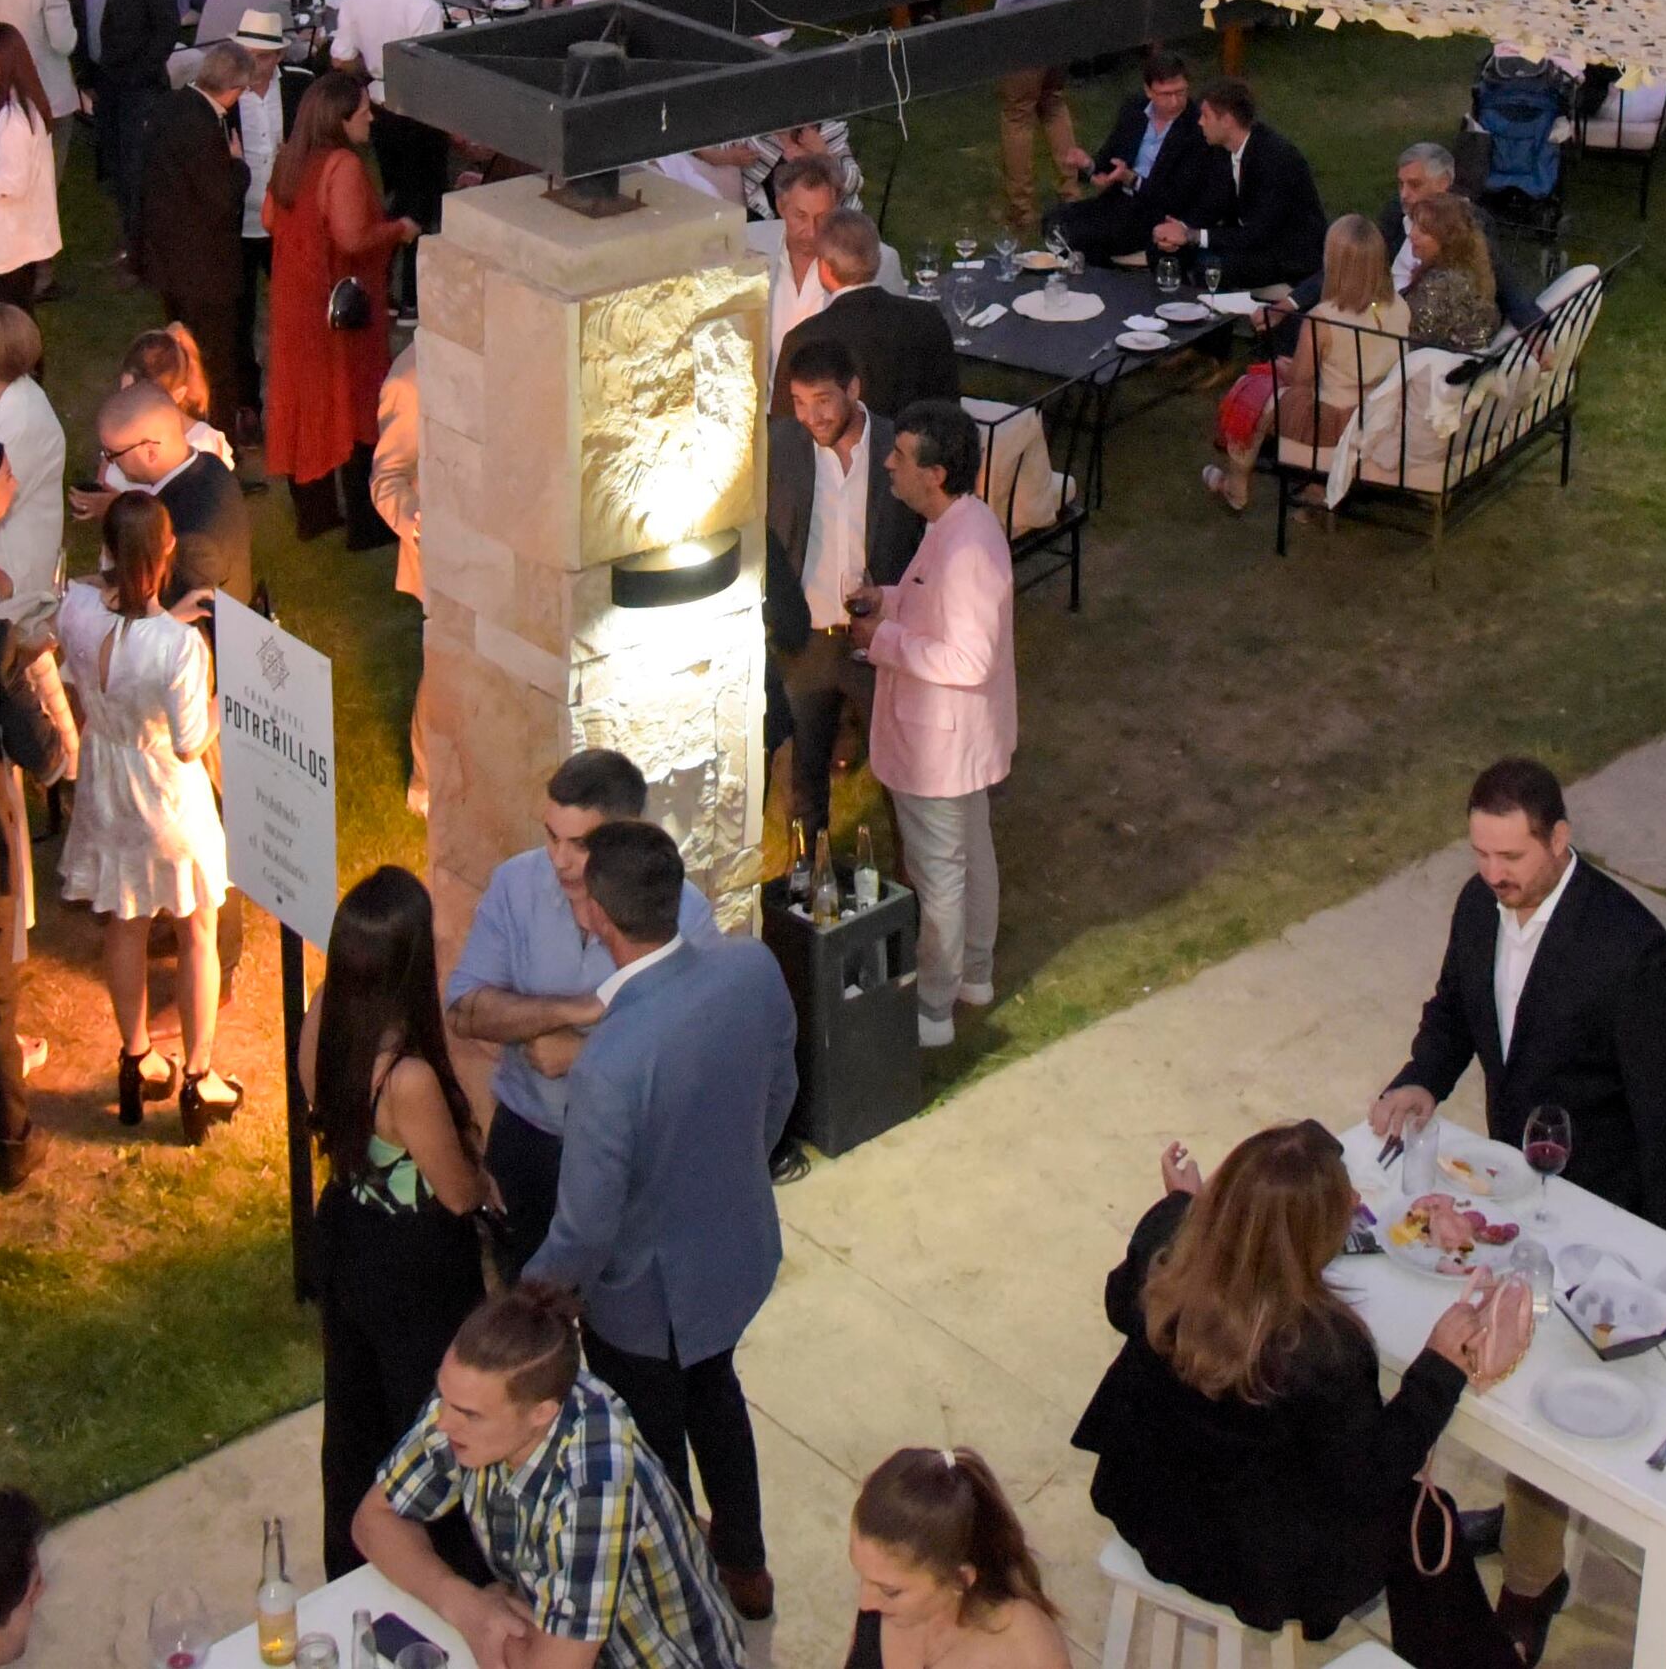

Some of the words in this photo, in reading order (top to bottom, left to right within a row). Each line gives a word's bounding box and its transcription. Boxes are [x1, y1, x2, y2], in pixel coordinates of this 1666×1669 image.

[244, 685, 270, 709] GRAN
[224, 694, 328, 788] POTRERILLOS
[255, 786, 301, 829] Prohibido
